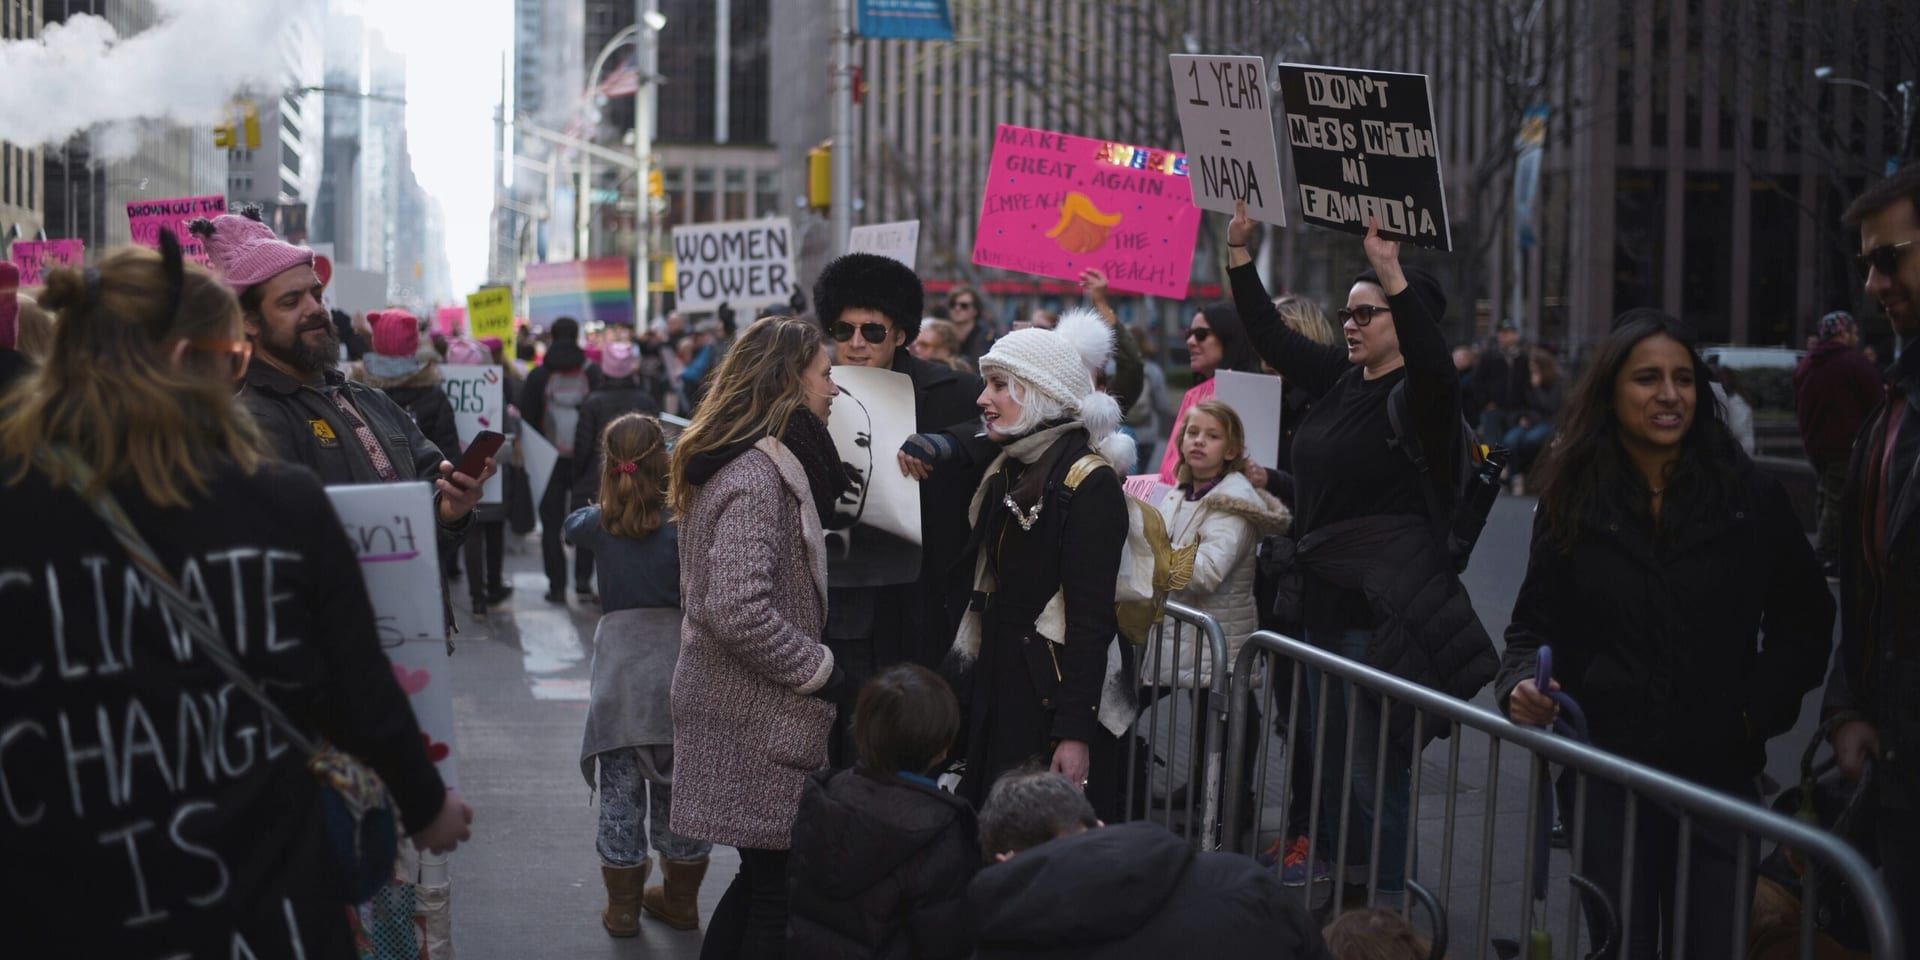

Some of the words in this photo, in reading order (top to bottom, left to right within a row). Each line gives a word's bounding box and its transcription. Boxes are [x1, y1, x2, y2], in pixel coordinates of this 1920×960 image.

[1188, 60, 1209, 106] 1
[1209, 61, 1263, 110] YEAR
[1305, 73, 1389, 109] DON'T
[1000, 127, 1067, 153] MAKE
[1289, 116, 1357, 150] MESS
[1006, 155, 1077, 180] GREAT
[1095, 142, 1189, 177] AMERIC
[1200, 155, 1264, 208] NADA
[128, 203, 171, 218] DROWN
[173, 200, 196, 214] OUT
[200, 199, 225, 212] THE
[675, 227, 788, 264] WOMEN
[1113, 232, 1150, 250] THE
[677, 264, 789, 300] POWER
[0, 548, 303, 686] CLIMATE
[98, 801, 230, 927] IS
